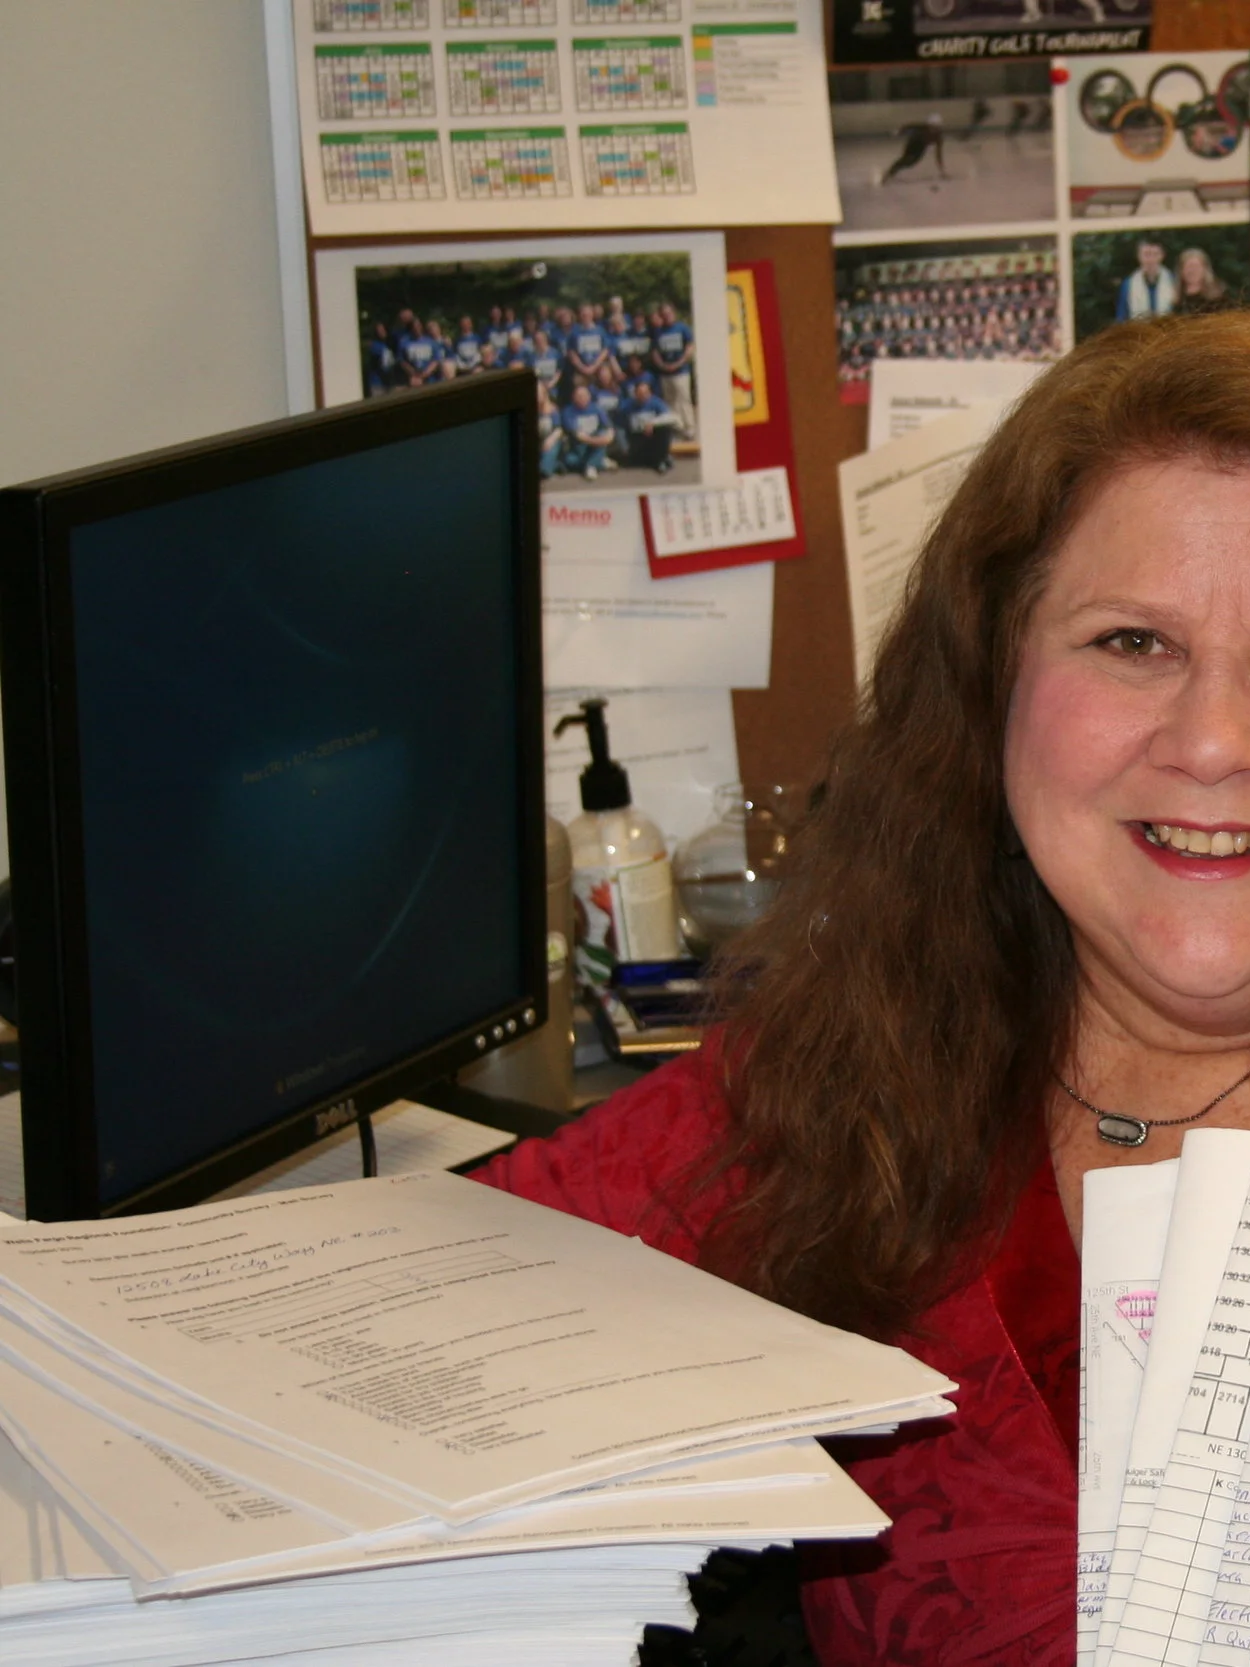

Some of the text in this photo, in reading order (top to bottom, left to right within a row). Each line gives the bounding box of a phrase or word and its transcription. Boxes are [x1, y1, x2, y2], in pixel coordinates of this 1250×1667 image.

[918, 29, 1142, 58] CHARITY GOLF TOURNAMENT
[548, 506, 612, 524] Memo
[315, 1098, 359, 1136] DELL
[1217, 1391, 1245, 1405] 2714
[1207, 1443, 1225, 1455] NE
[1215, 1479, 1223, 1488] K
